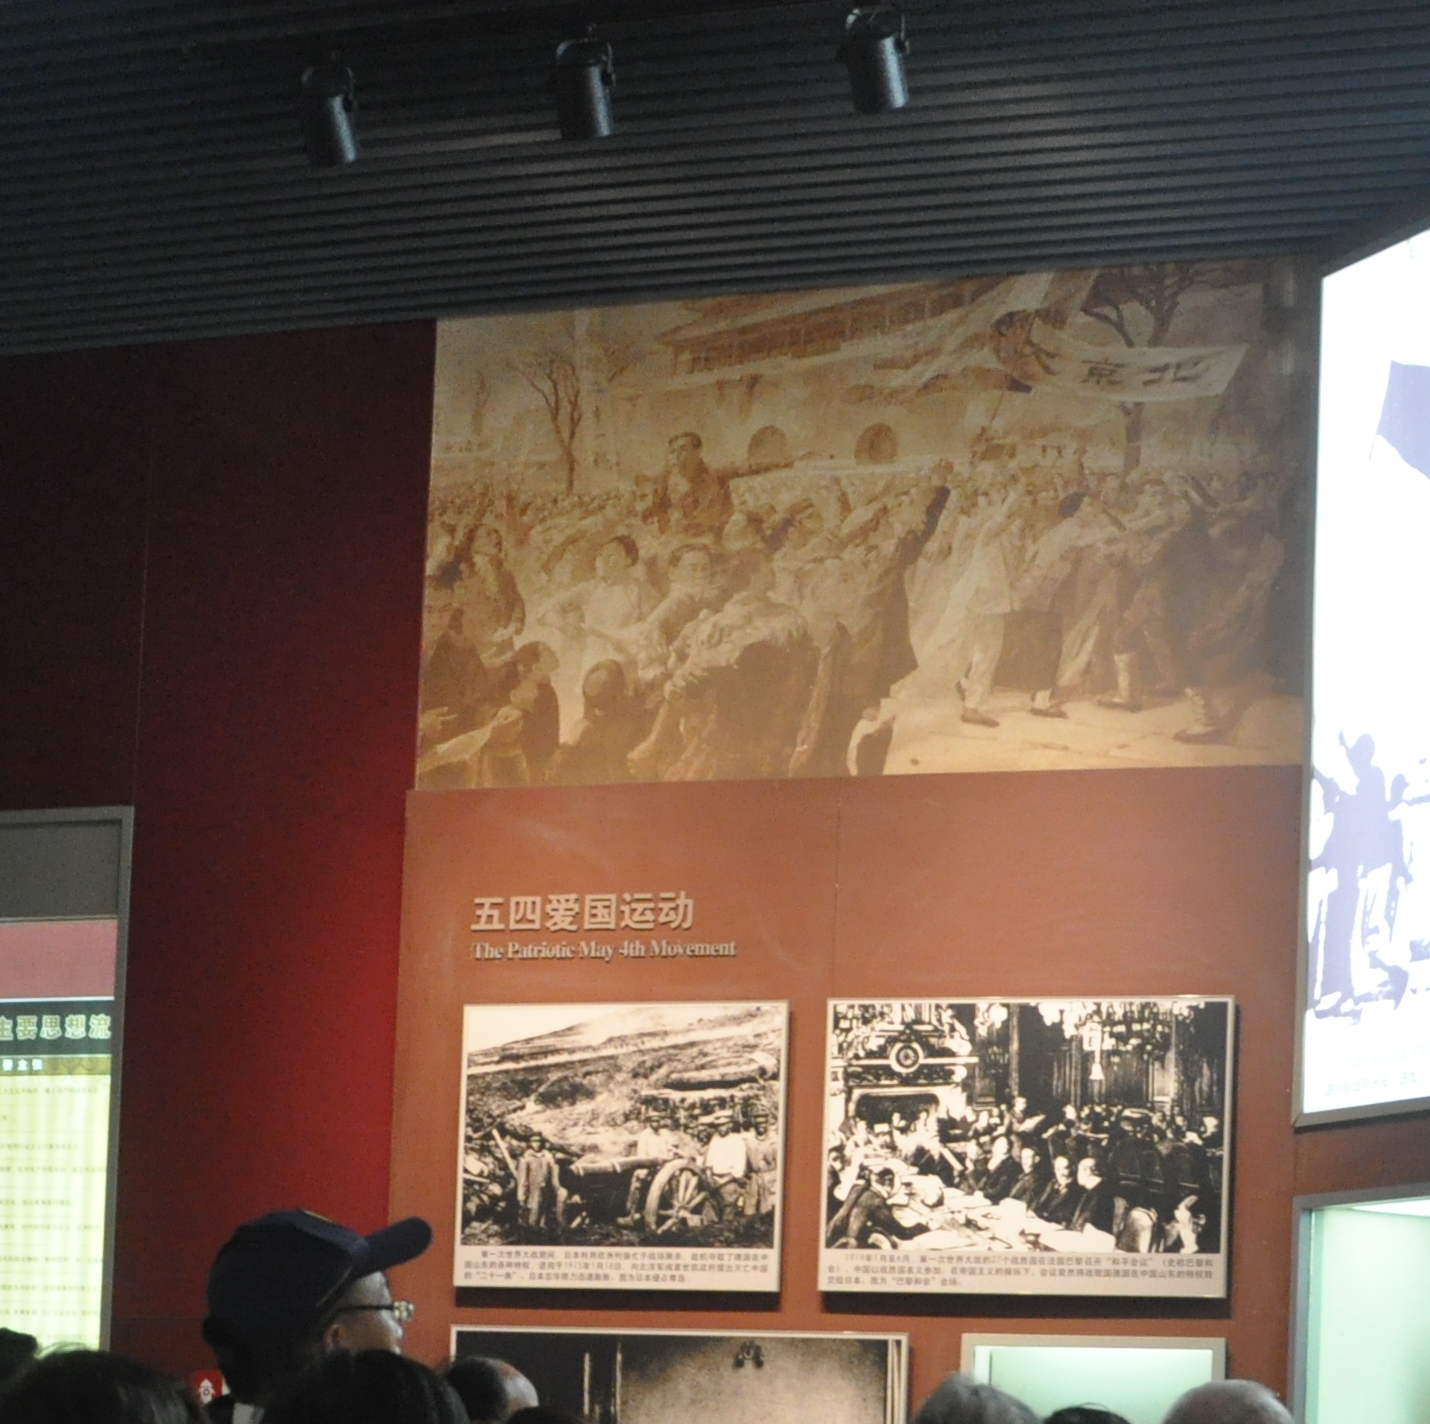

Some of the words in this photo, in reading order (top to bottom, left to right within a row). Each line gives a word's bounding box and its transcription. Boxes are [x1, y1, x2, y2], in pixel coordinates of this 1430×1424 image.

[470, 891, 695, 932] 五四爱国运动
[472, 941, 504, 960] The
[507, 940, 574, 961] Patriotic
[578, 941, 616, 963] May
[618, 939, 646, 958] 4th
[649, 939, 737, 958] Movement
